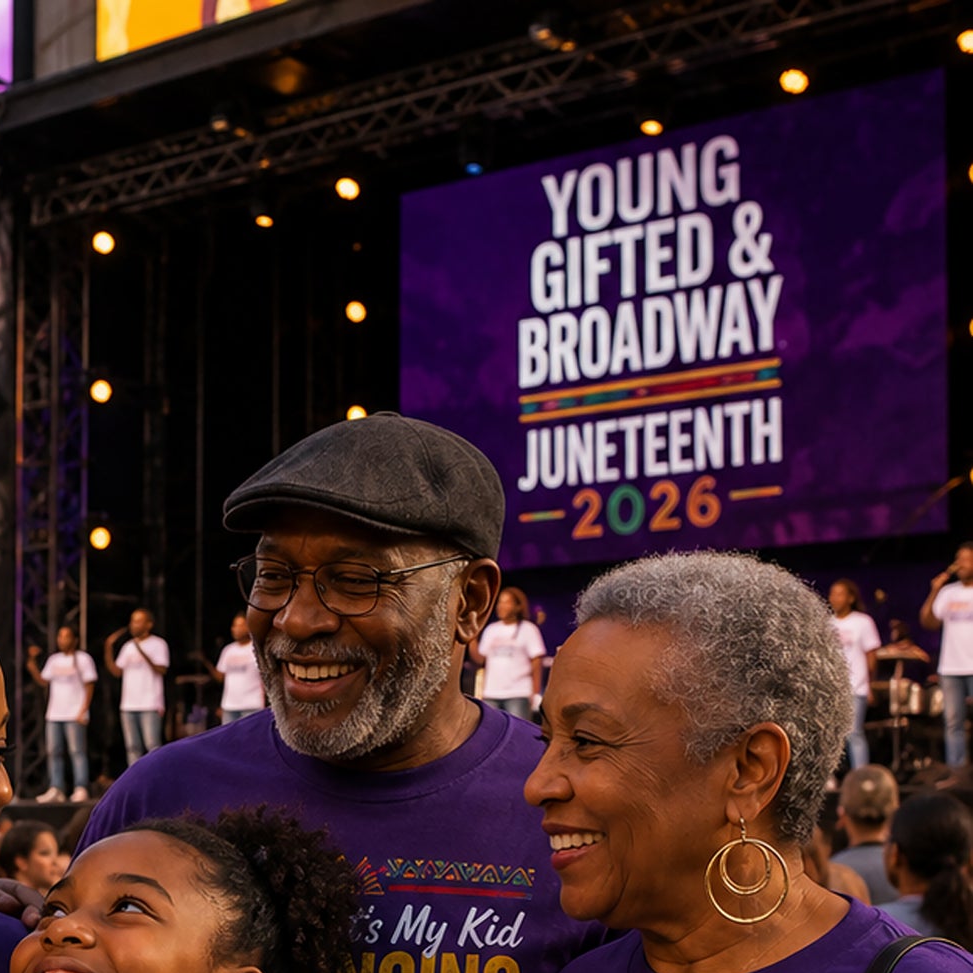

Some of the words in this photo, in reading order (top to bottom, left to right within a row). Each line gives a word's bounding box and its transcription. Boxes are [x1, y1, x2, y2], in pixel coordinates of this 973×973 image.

[540, 134, 741, 239] YOUNG
[530, 212, 715, 314] GIFTED
[728, 200, 775, 278] &
[518, 274, 784, 389] BROADWAY
[518, 396, 783, 492] JUNETEENTH
[571, 475, 722, 540] 2026
[390, 903, 448, 959] My
[457, 906, 527, 949] Kid
